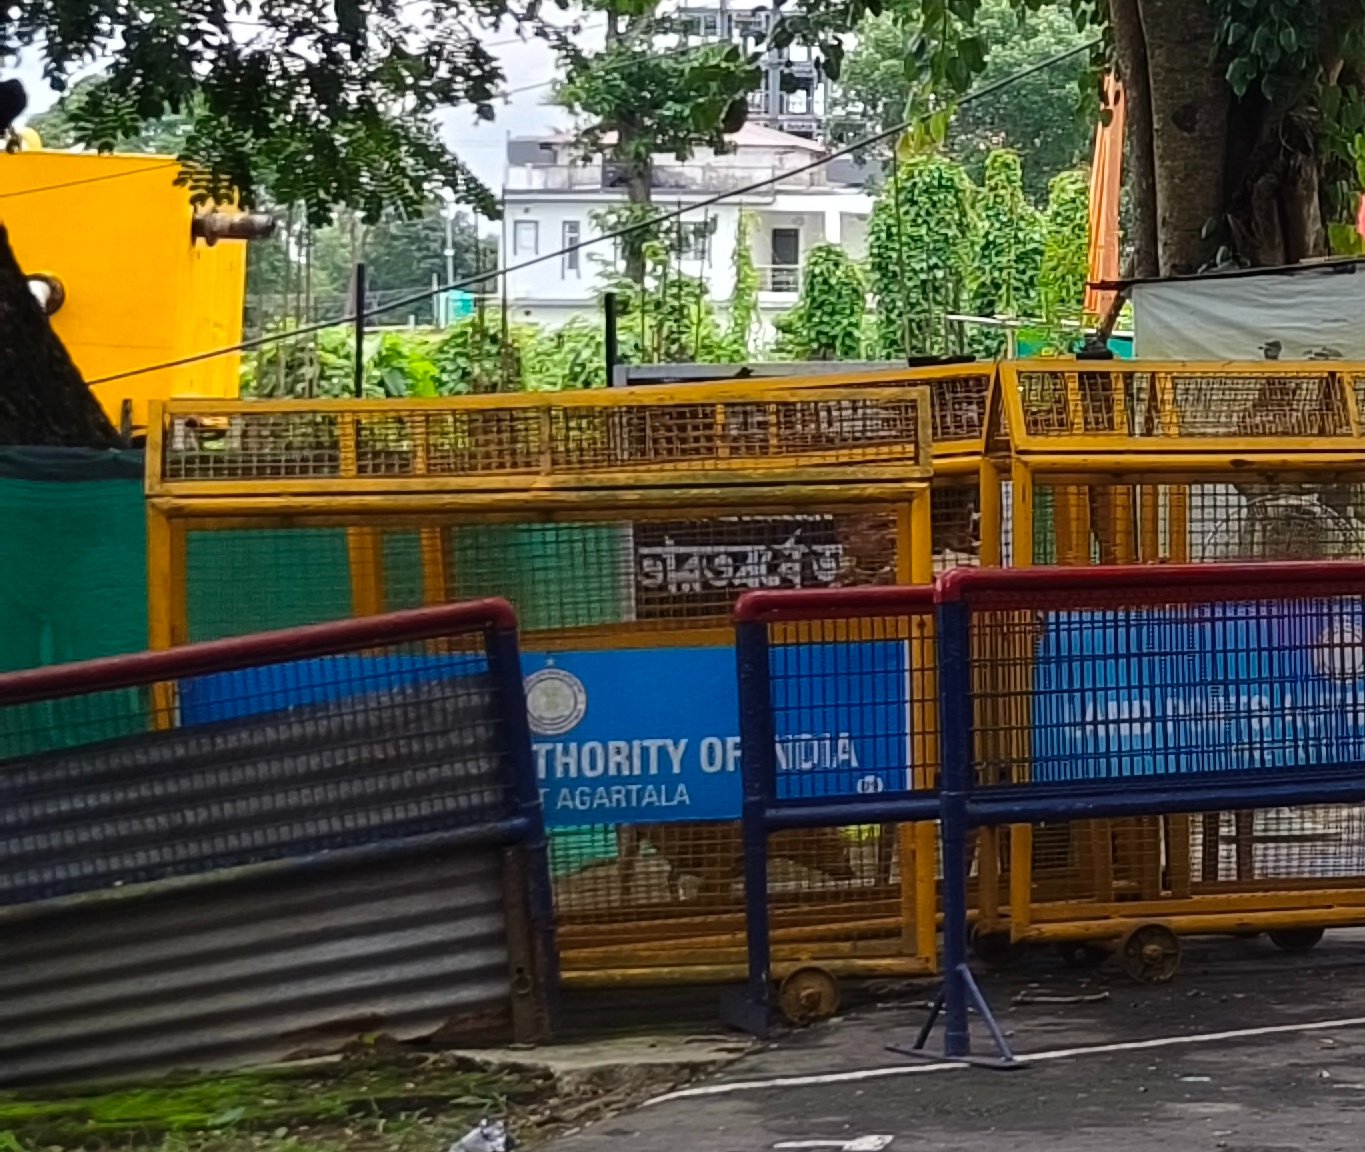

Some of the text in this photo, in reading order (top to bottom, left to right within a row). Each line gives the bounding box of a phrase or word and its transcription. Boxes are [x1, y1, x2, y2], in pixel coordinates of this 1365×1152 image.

[534, 738, 688, 780] THORITY
[775, 732, 859, 772] NDIA
[556, 784, 691, 810] AGARTALA
